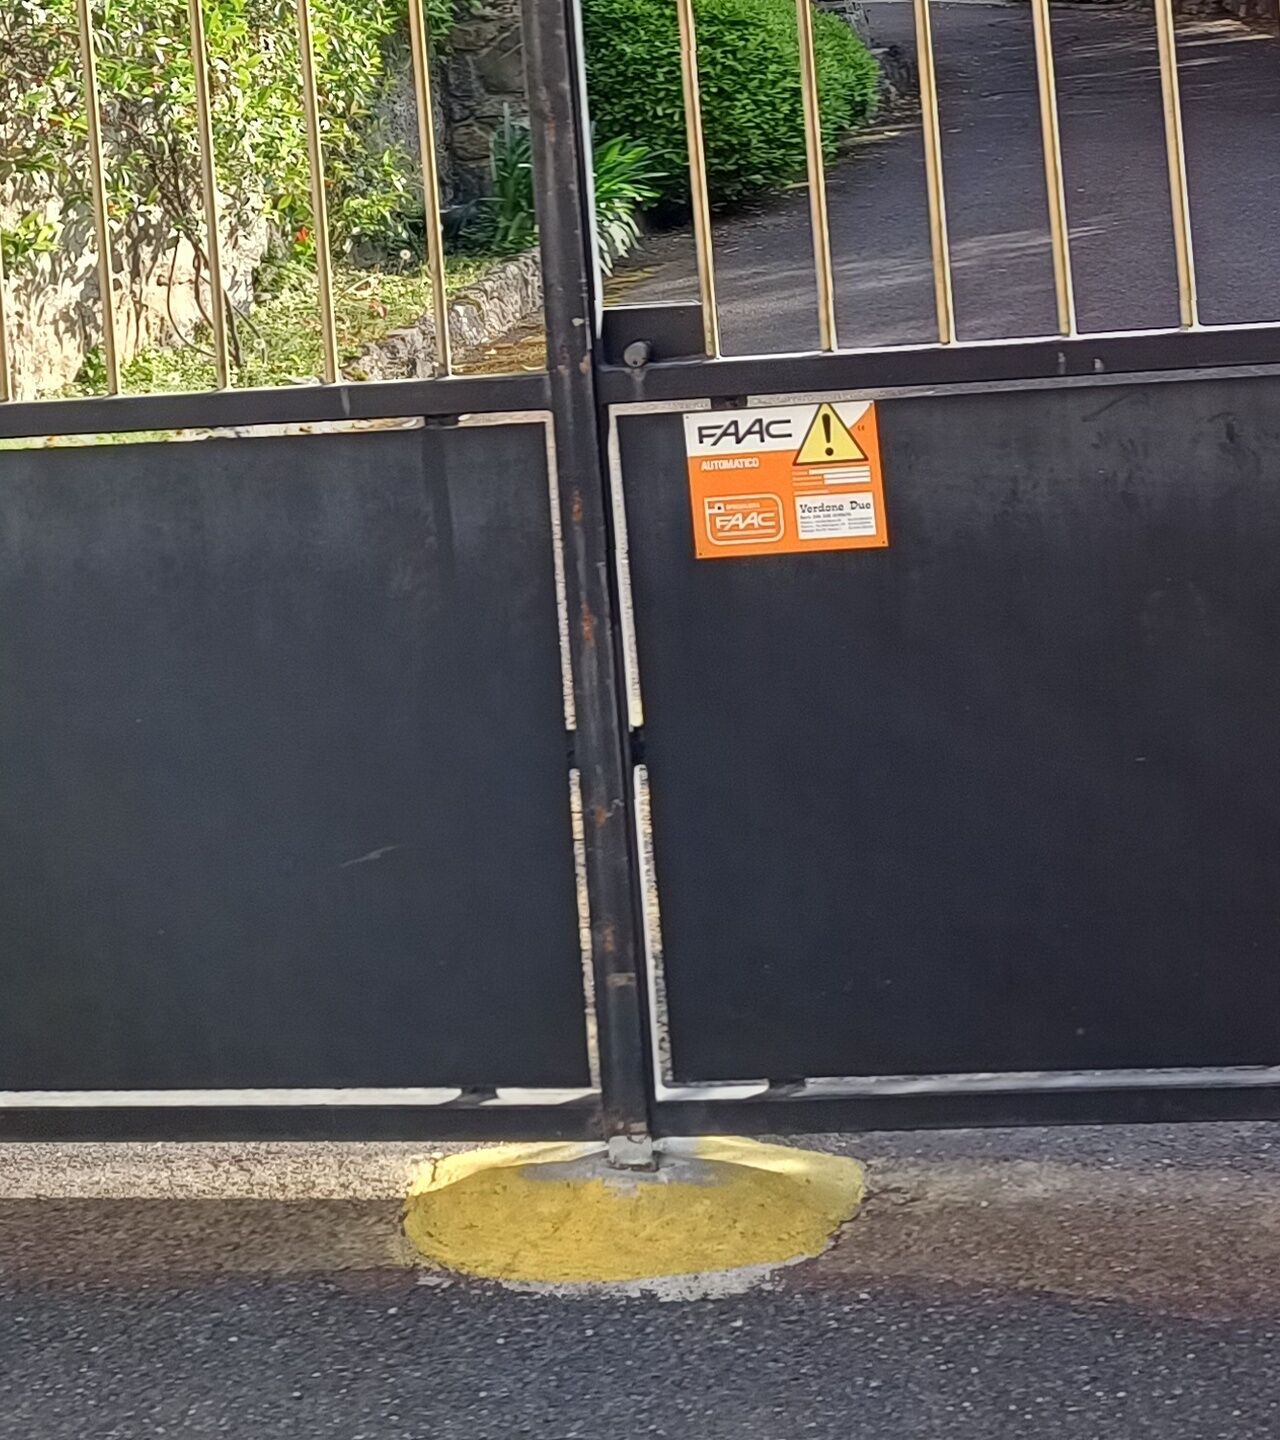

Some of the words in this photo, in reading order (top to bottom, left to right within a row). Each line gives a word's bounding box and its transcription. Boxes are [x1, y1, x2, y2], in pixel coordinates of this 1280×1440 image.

[697, 418, 793, 446] FAAC
[701, 457, 760, 471] AUTOMATICO
[799, 502, 845, 513] Verdone
[849, 500, 872, 510] Due
[715, 511, 776, 530] FAAC
